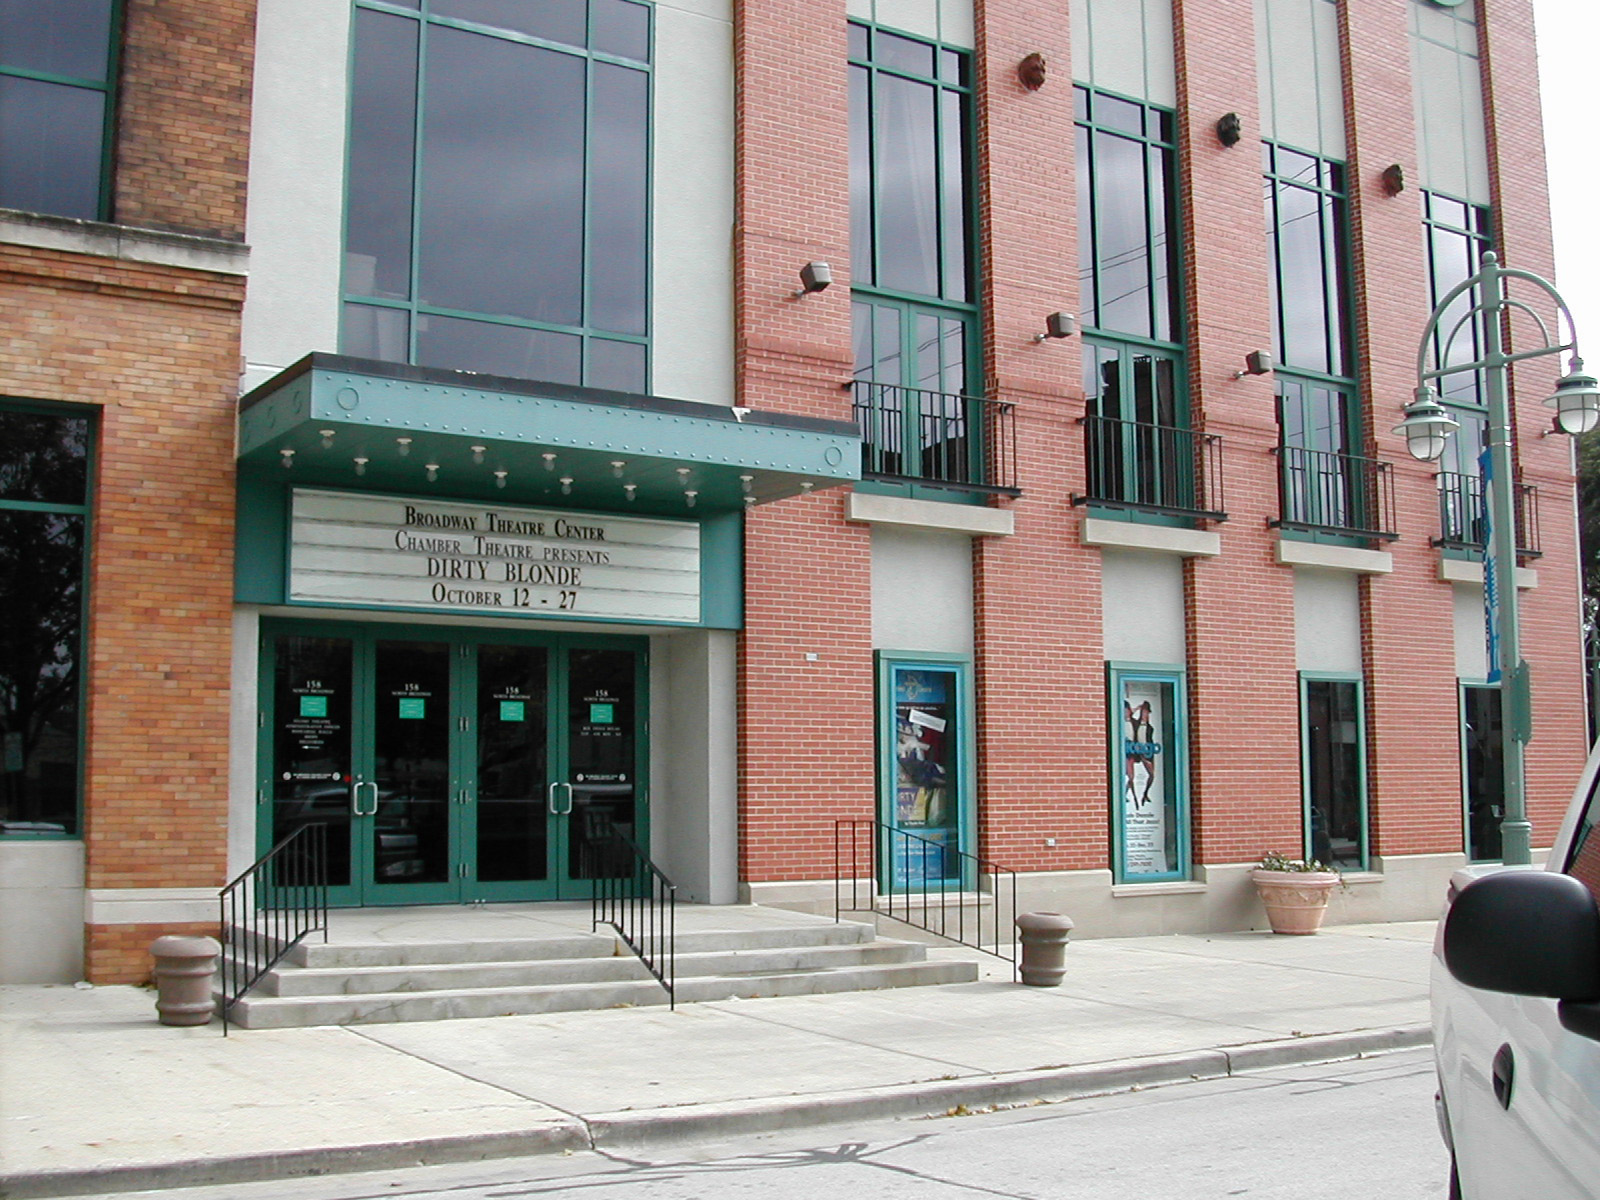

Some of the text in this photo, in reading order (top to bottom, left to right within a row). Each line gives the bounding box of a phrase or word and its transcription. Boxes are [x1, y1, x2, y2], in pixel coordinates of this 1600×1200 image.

[405, 505, 605, 541] BROADWAY THEATRE CENTER
[394, 528, 610, 565] CHAMBER THEATRE PRESENTS
[427, 557, 581, 586] DIRTY BLONDE
[431, 581, 502, 606] OCTOBER
[512, 588, 530, 608] 12
[558, 590, 577, 611] 27
[306, 680, 322, 688] 158
[404, 683, 420, 691] 158
[505, 686, 520, 694] 158
